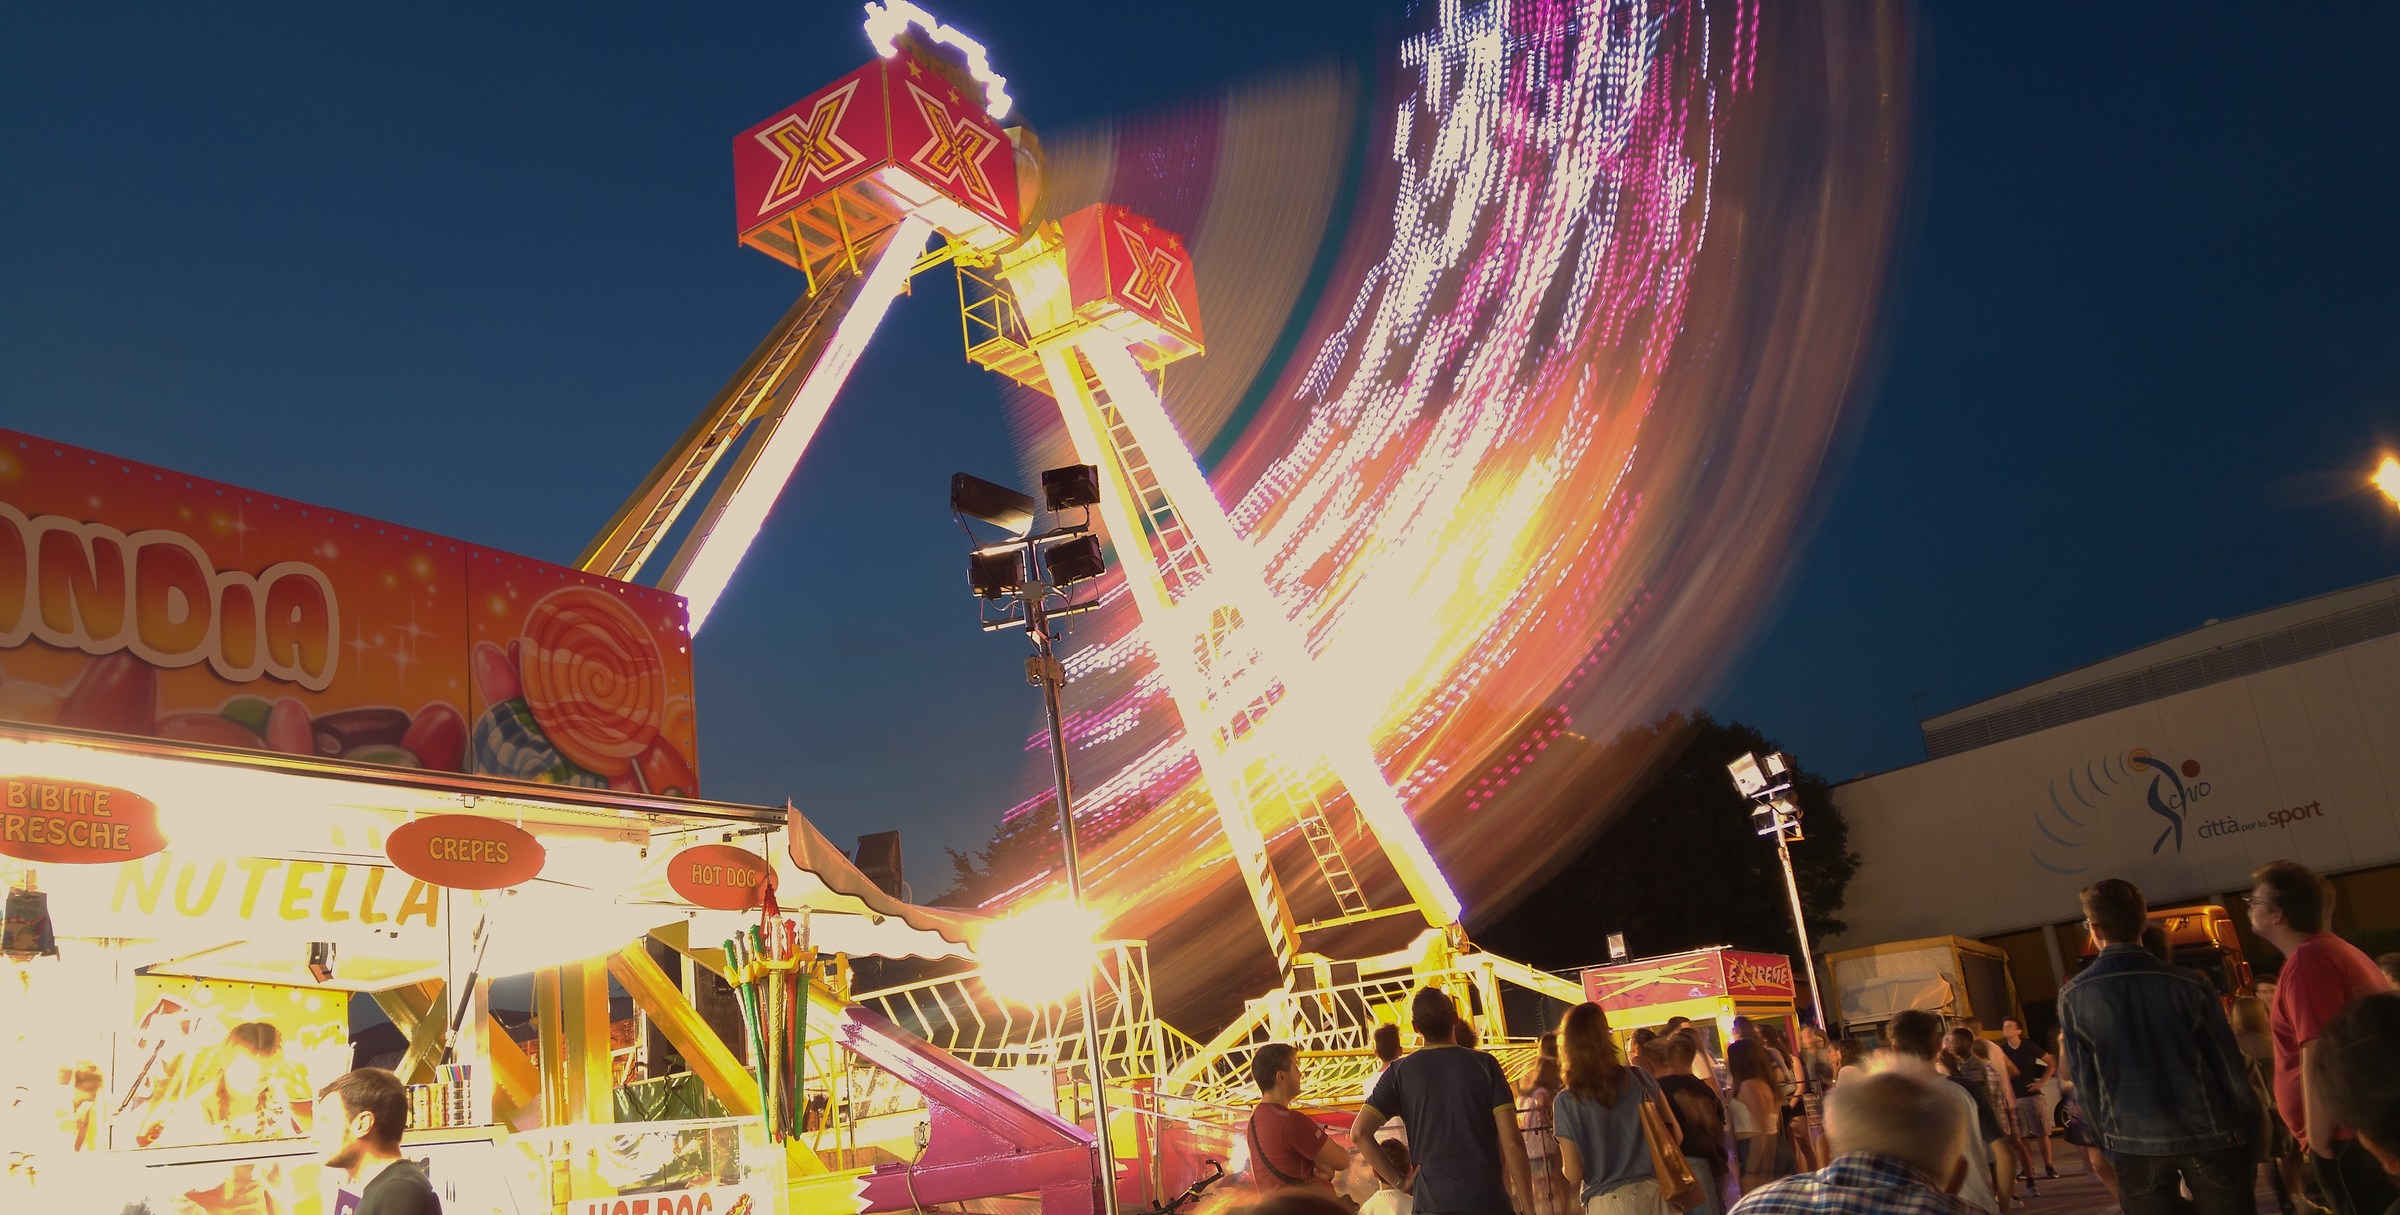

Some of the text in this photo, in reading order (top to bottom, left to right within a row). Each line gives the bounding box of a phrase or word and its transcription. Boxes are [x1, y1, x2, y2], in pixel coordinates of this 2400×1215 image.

[7, 781, 112, 817] BIBITE
[0, 813, 131, 851] RESCHE
[2198, 800, 2324, 839] città per lo sport
[429, 836, 509, 864] CREPES
[111, 850, 439, 928] NUTELLA
[692, 864, 756, 888] HOT DOG
[1727, 958, 1788, 991] EXTREME
